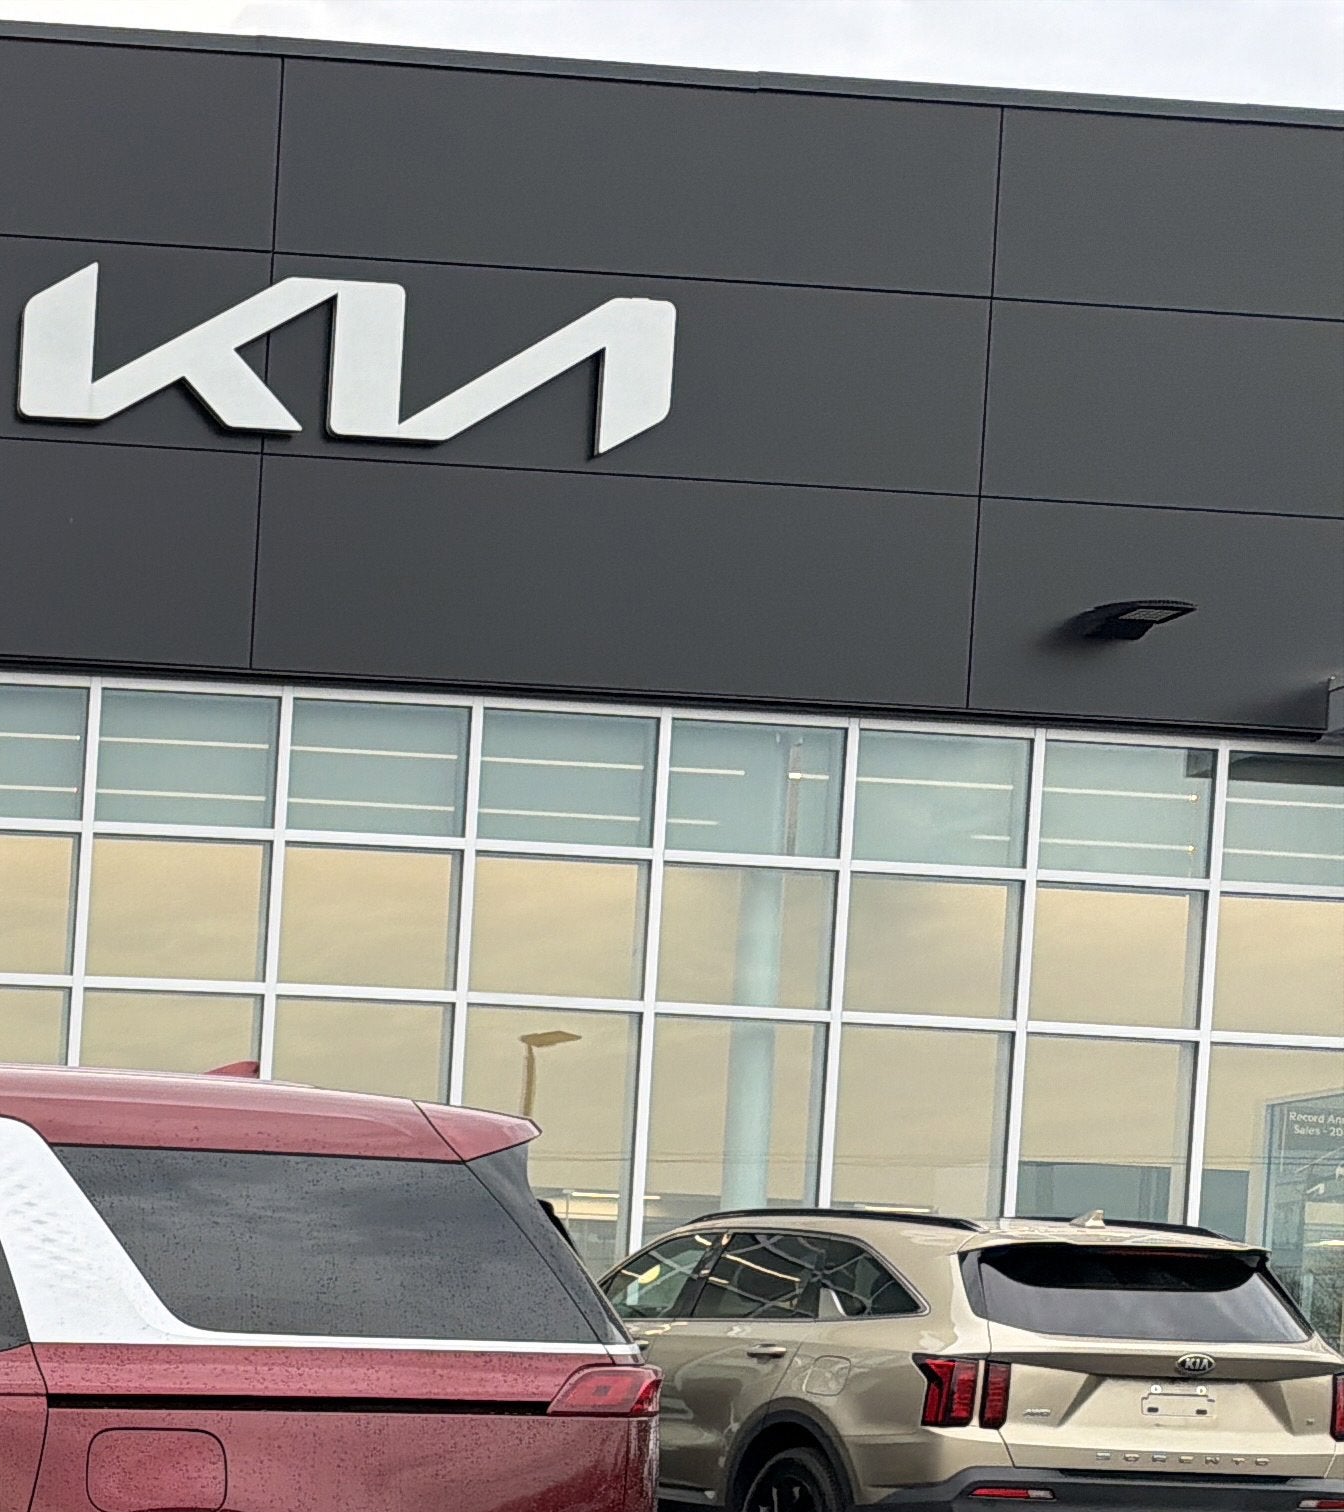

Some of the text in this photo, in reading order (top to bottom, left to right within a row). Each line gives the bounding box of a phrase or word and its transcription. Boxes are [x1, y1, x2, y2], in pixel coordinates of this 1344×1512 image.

[17, 261, 677, 457] KIA
[1289, 1111, 1325, 1124] Record
[1294, 1124, 1321, 1136] Sales
[1184, 1357, 1210, 1370] KIA
[1095, 1451, 1270, 1467] SORENTO
